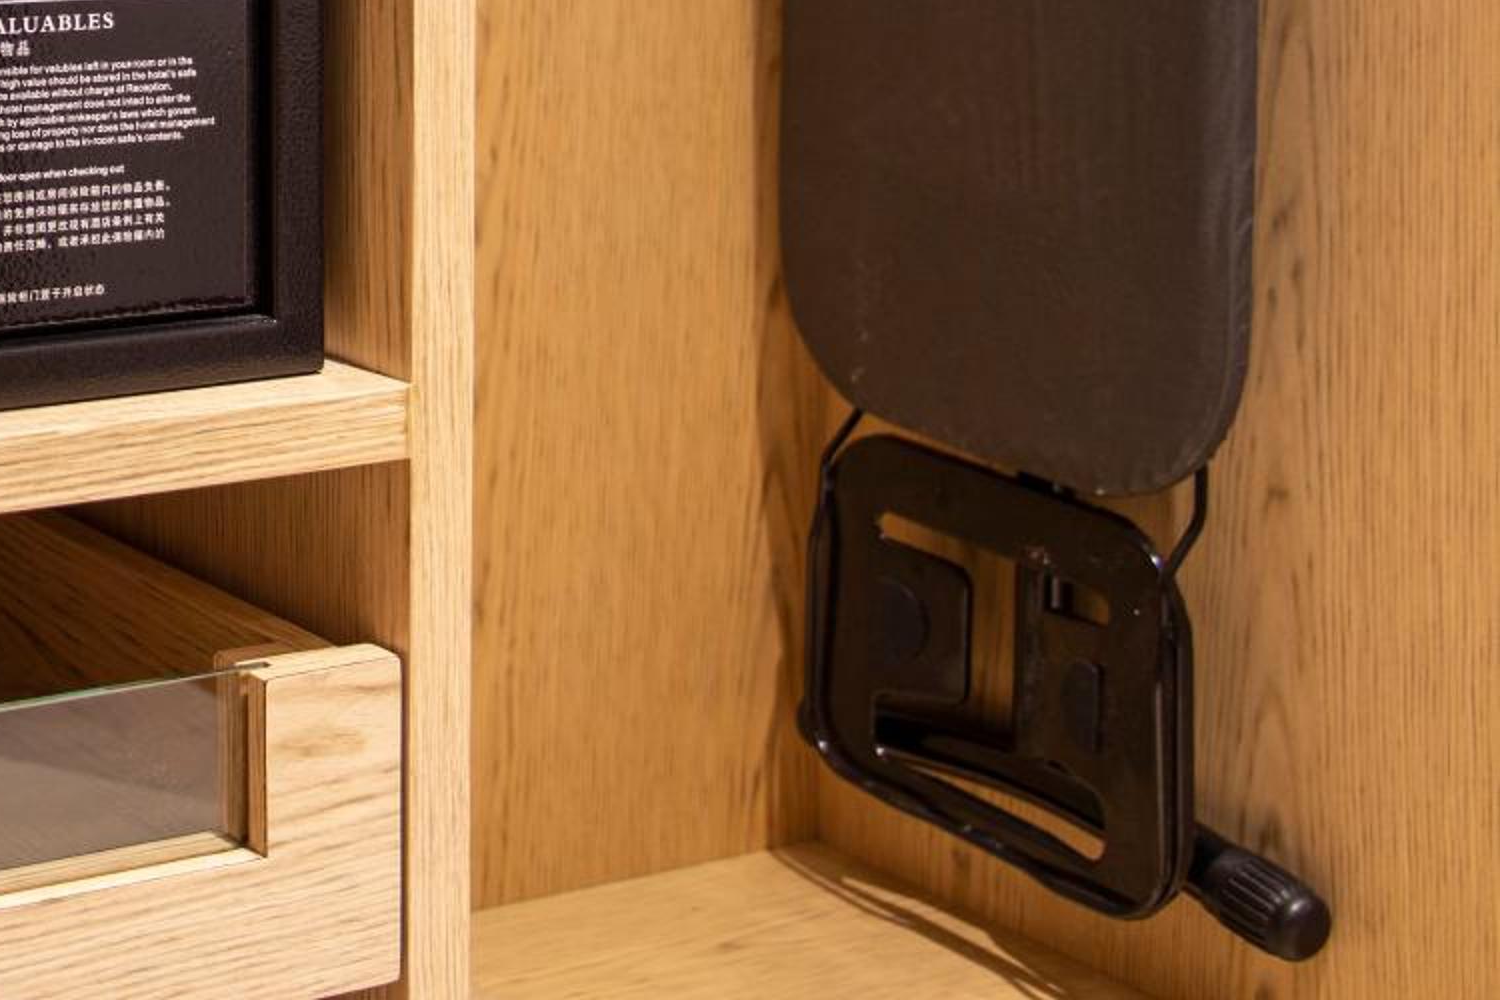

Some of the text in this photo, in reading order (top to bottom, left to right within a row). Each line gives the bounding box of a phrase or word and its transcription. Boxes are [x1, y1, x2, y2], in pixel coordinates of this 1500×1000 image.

[29, 65, 44, 74] for
[177, 56, 193, 65] the
[0, 79, 21, 90] high
[21, 77, 46, 87] value
[47, 75, 79, 85] should
[80, 74, 90, 83] be
[92, 73, 120, 83] stored
[121, 72, 130, 81] in
[131, 71, 146, 80] the
[177, 68, 196, 77] safe
[9, 90, 50, 101] available
[51, 88, 82, 98] without
[83, 86, 115, 98] charge
[115, 85, 125, 94] at
[23, 100, 82, 115] management
[83, 99, 105, 109] does
[106, 98, 121, 107] not
[145, 96, 154, 105] to
[6, 117, 19, 129] by
[140, 108, 166, 118] which
[11, 129, 30, 139] loss
[31, 128, 42, 138] of
[80, 126, 96, 134] nor
[97, 123, 118, 133] does
[119, 122, 134, 132] the
[17, 140, 55, 153] damage
[55, 140, 65, 148] to
[66, 138, 81, 147] the
[18, 172, 41, 183] open
[42, 169, 67, 179] when
[67, 166, 108, 180] checking
[109, 165, 124, 175] out
